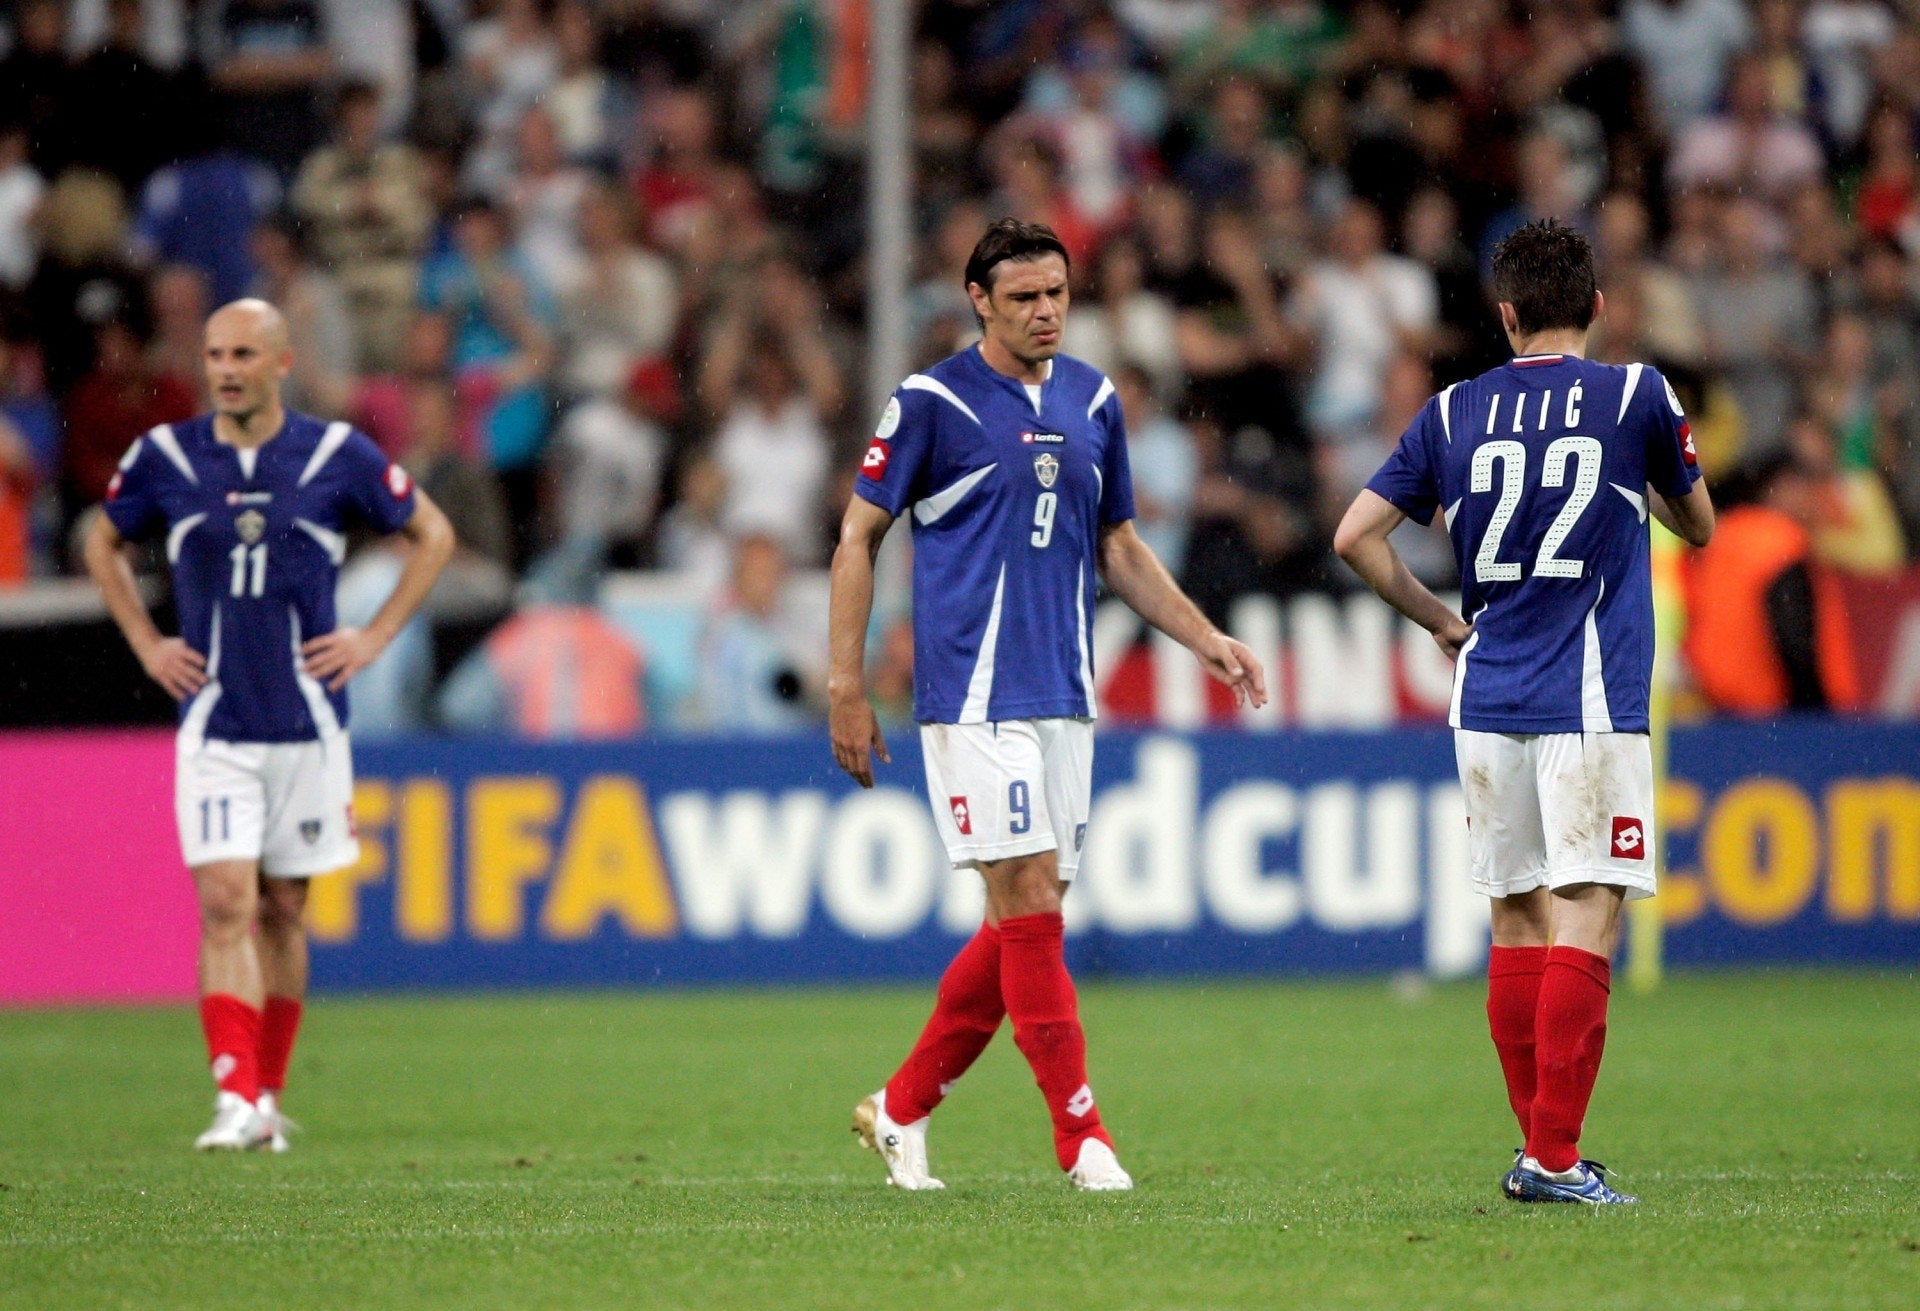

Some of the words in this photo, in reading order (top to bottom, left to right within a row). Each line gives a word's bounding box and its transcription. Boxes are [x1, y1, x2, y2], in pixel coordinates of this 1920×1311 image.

[1486, 379, 1583, 434] ILIĆ
[1031, 492, 1057, 547] 9
[1471, 436, 1602, 582] 22
[229, 543, 267, 598] 11
[200, 796, 229, 842] 11
[1009, 780, 1030, 834] 9
